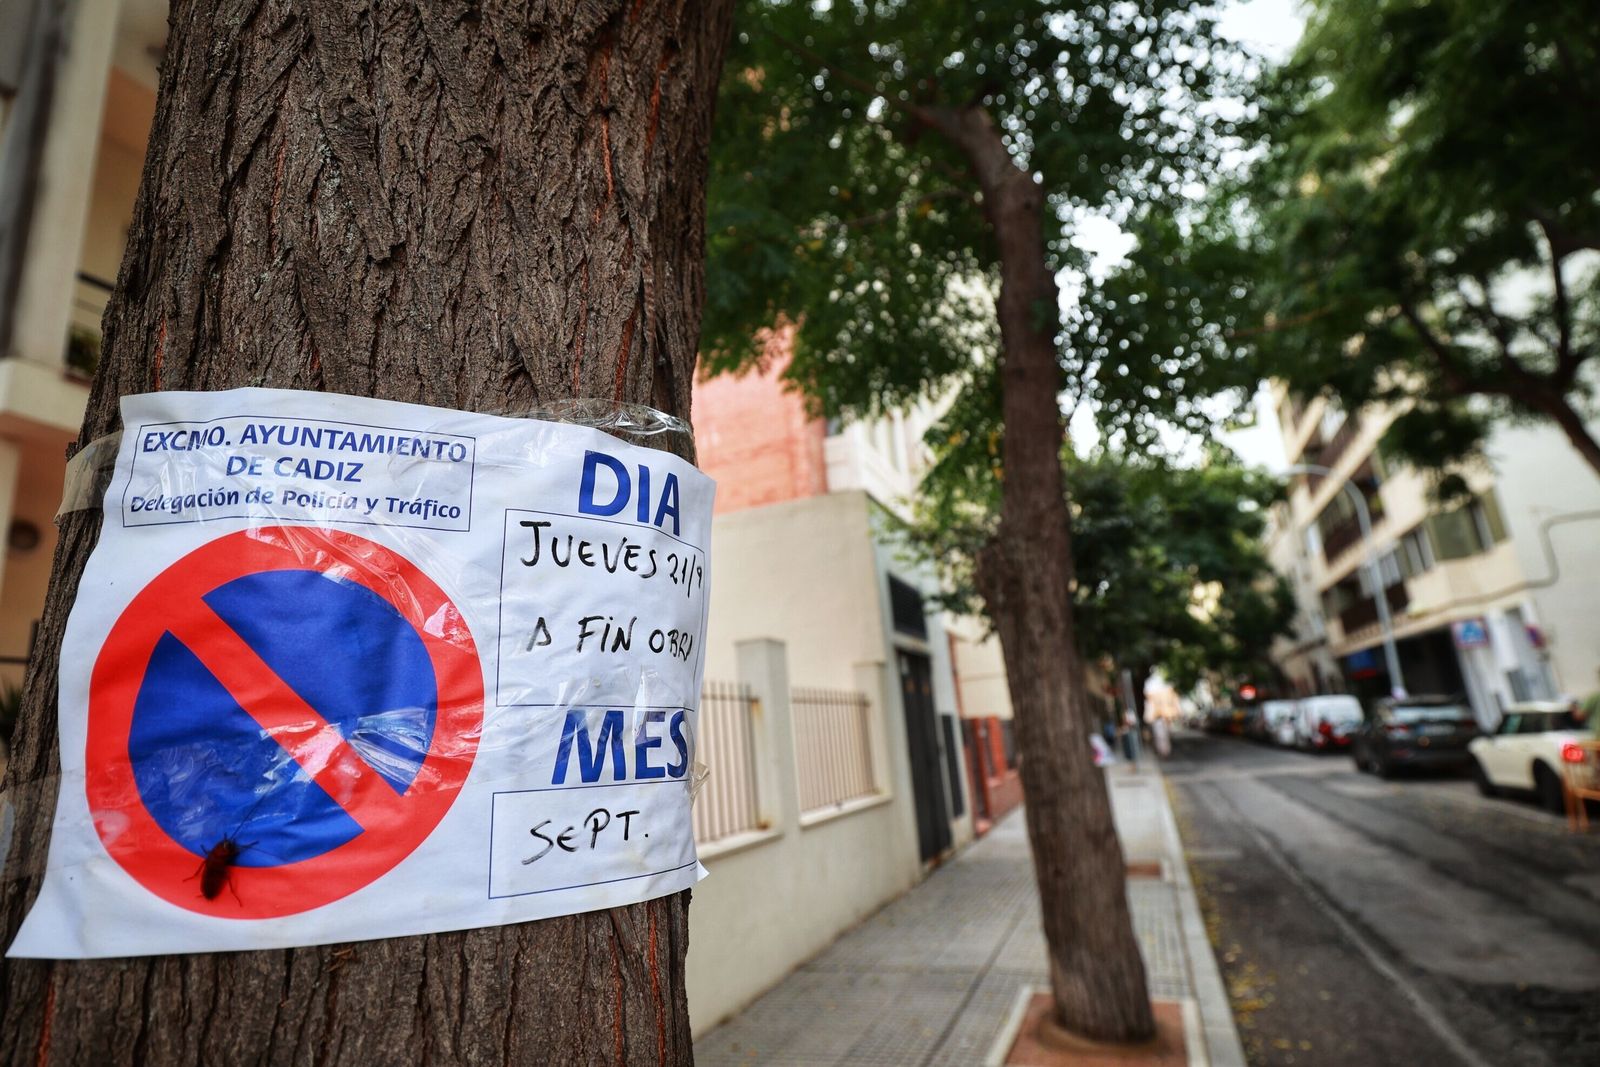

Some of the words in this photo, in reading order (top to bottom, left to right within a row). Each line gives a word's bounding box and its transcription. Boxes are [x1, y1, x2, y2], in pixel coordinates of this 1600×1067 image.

[142, 426, 231, 453] EXCMO.
[240, 424, 467, 463] AYUNTAMIENTO
[226, 455, 263, 476] DE
[274, 456, 364, 482] CADIZ
[130, 486, 239, 515] Delegación
[245, 486, 273, 505] de
[282, 489, 357, 511] Policía
[363, 495, 379, 515] y
[386, 496, 461, 519] Tráfico
[577, 450, 681, 537] DIA
[519, 520, 657, 579] JUEVES
[667, 553, 703, 599] 21/9
[551, 709, 689, 785] MES
